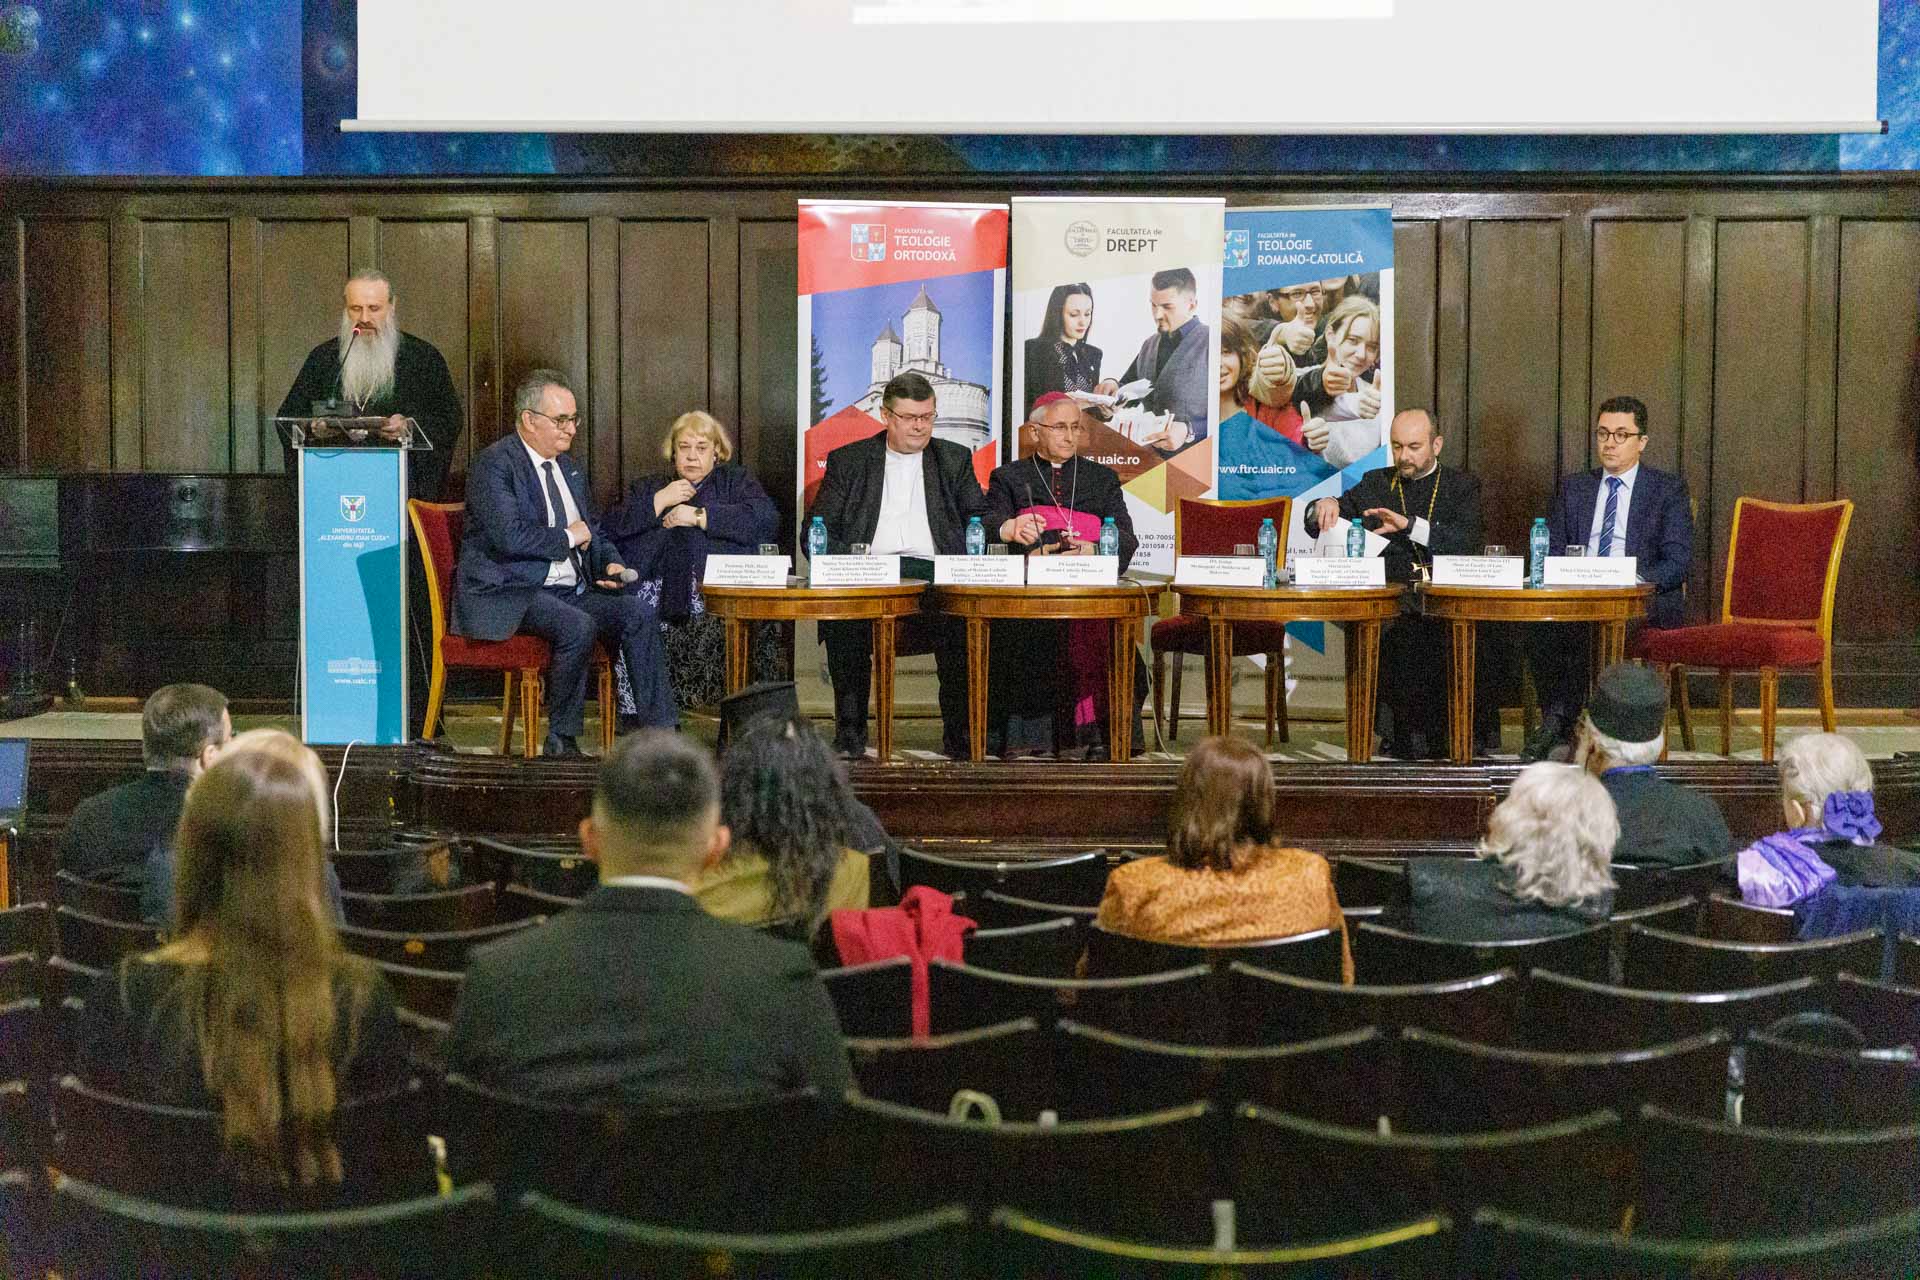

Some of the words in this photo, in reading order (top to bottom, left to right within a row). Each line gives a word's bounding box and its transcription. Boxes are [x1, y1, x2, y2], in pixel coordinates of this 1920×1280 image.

[894, 236, 951, 246] TEOLOGIE
[1106, 239, 1158, 252] DREPT
[1257, 240, 1313, 251] TEOLOGIE
[894, 248, 956, 261] ORTODOXĂ
[1257, 250, 1364, 266] ROMANO-CATOLICĂ
